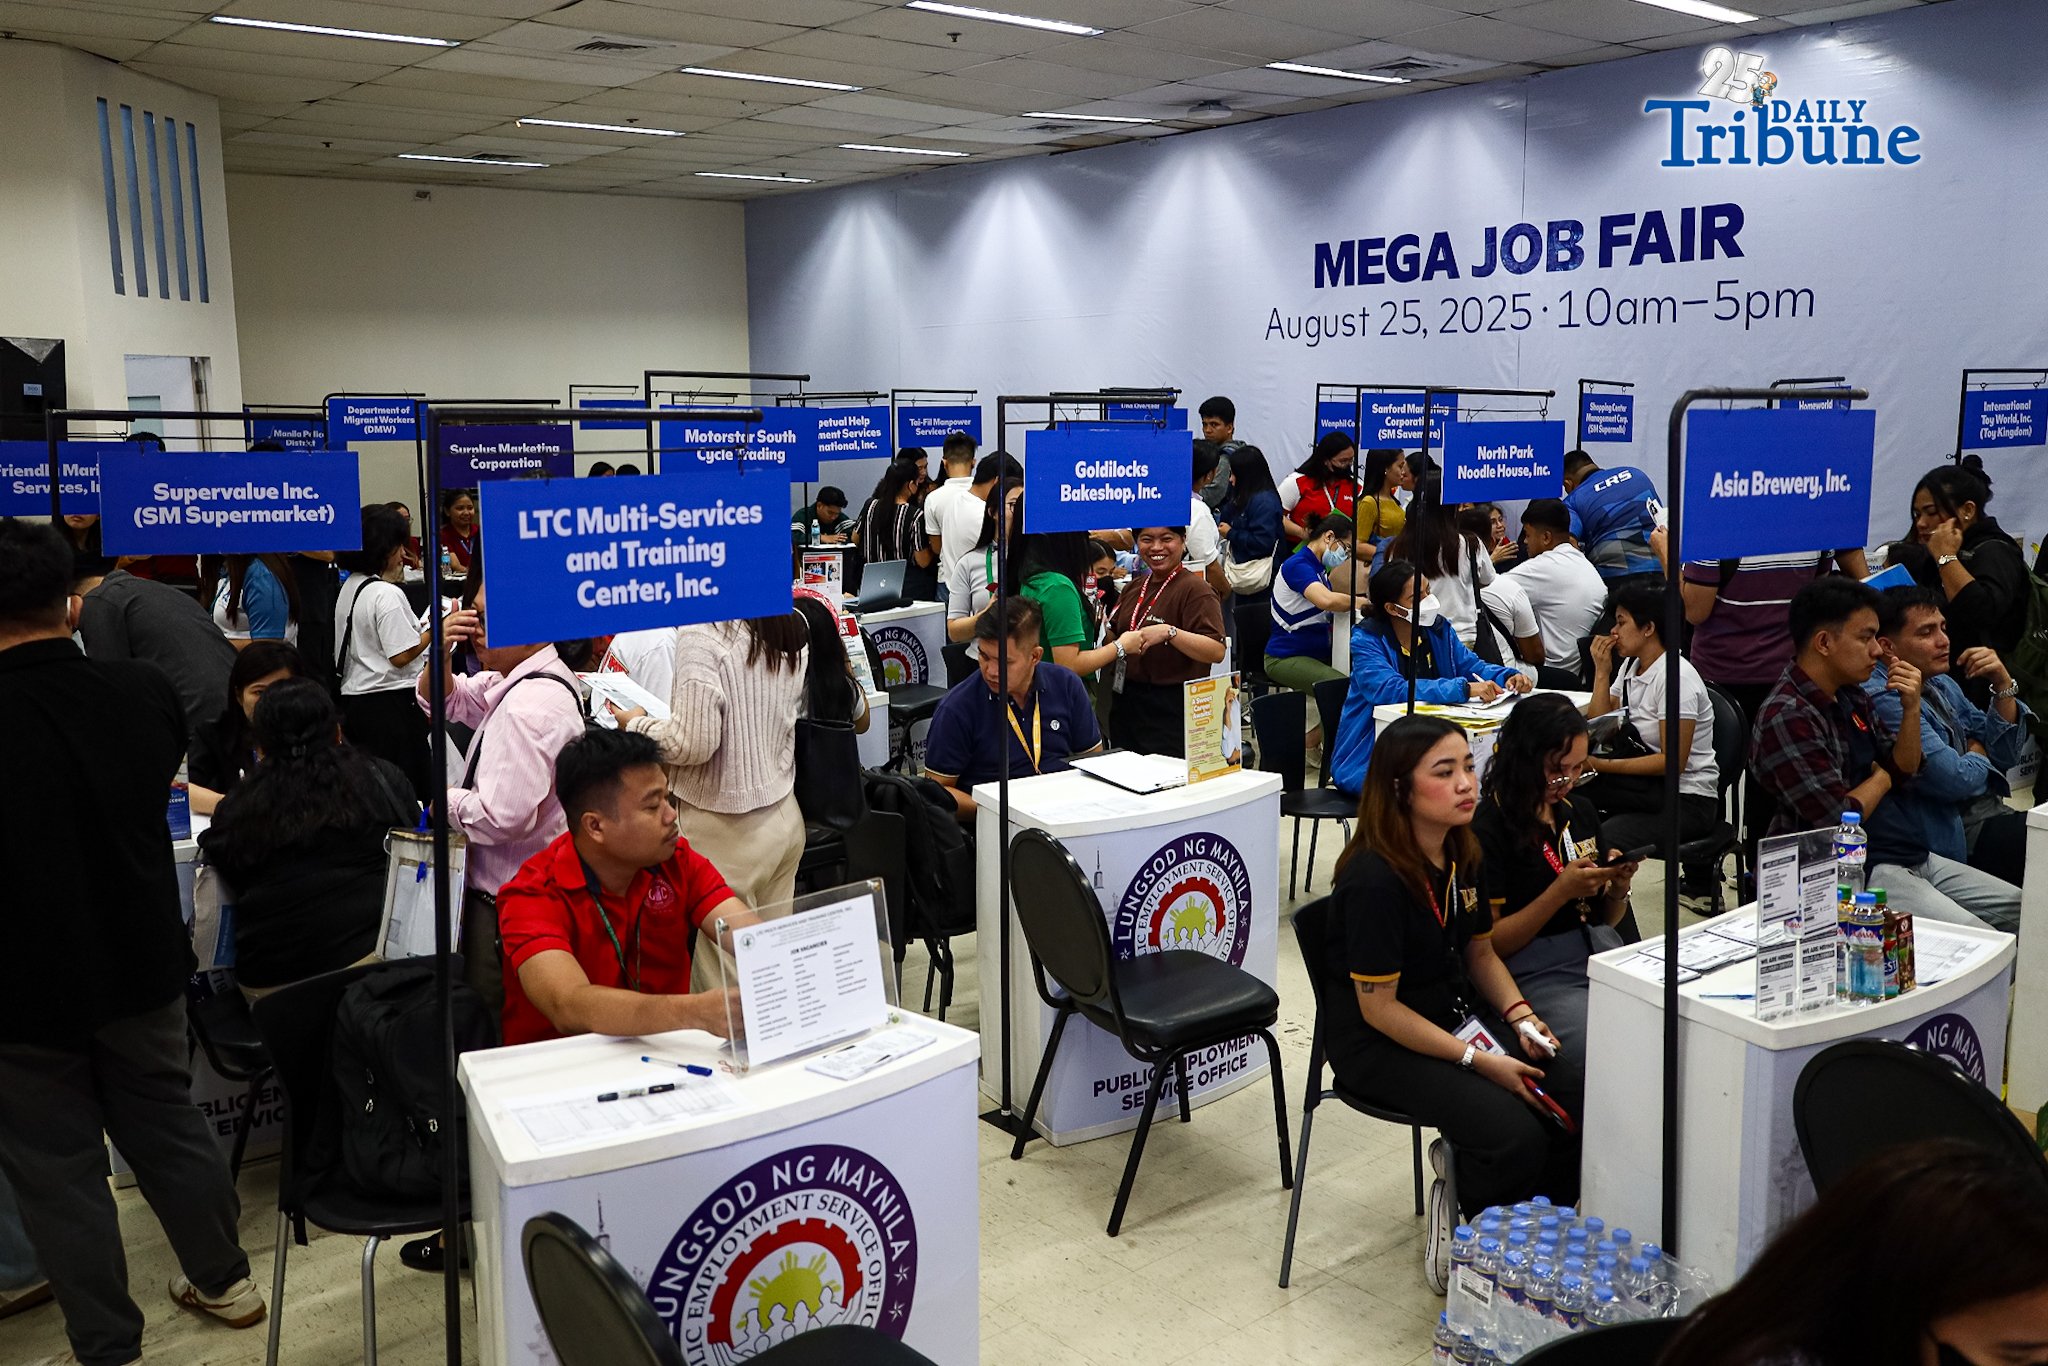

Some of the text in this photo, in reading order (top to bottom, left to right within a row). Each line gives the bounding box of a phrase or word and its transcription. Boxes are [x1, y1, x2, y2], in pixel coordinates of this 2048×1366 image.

[1314, 202, 1745, 288] MEGA JOB FAIR
[1265, 306, 1370, 348] August
[1379, 299, 1428, 339] 25,
[348, 405, 410, 416] Department of
[1372, 403, 1449, 415] Sanford Marting
[1799, 399, 1833, 410] Homeworld
[1984, 400, 2032, 411] International
[344, 415, 415, 425] Migrant Workers
[848, 415, 870, 428] Help
[909, 418, 972, 427] Tai-Fil Manpower
[1321, 420, 1347, 429] Wenphil
[1385, 416, 1434, 428] Corporatin
[1981, 413, 2032, 427] Toy World, Inc.
[274, 429, 302, 438] Manila
[364, 425, 396, 435] (DMW)
[685, 428, 797, 443] Motorstar South
[842, 428, 882, 438] Services
[915, 427, 947, 436] Services
[1378, 428, 1441, 441] (SM Savemre)
[1980, 425, 2033, 440] (Toy Kingdom)
[450, 443, 560, 457] Surplus Marketing
[861, 440, 878, 449] Inc.
[697, 449, 734, 464] Cycle
[1477, 445, 1534, 460] North Park
[470, 457, 542, 471] Corporation
[1075, 460, 1149, 479] Goldilocks
[1457, 462, 1551, 480] Noodle House, Inc.
[12, 480, 88, 495] Servces,
[1593, 469, 1633, 492] CRS
[1710, 468, 1851, 500] Asia Brewery, Inc.
[153, 482, 319, 505] Supervalue Inc.
[1060, 482, 1162, 504] Bakeshop, Inc.
[133, 504, 335, 528] (SM Supermarket)
[518, 499, 763, 539] LTC Multi-Services
[566, 535, 726, 573] and Training
[576, 572, 719, 609] Center, Inc.
[884, 629, 899, 640] NG
[900, 631, 926, 673] MAYNILA
[1118, 838, 1249, 940] LUNGSOD NG MAYNILA
[1138, 862, 1204, 929] EMPLOYMENT
[1206, 862, 1234, 906] SERVICE
[1926, 1022, 1949, 1051] NG
[1197, 1052, 1248, 1087] OFFICE
[772, 1155, 815, 1190] NG
[825, 1156, 910, 1262] MAYNILA
[687, 1193, 814, 1319] EMPLOYMENT
[816, 1194, 879, 1257] SERVICE
